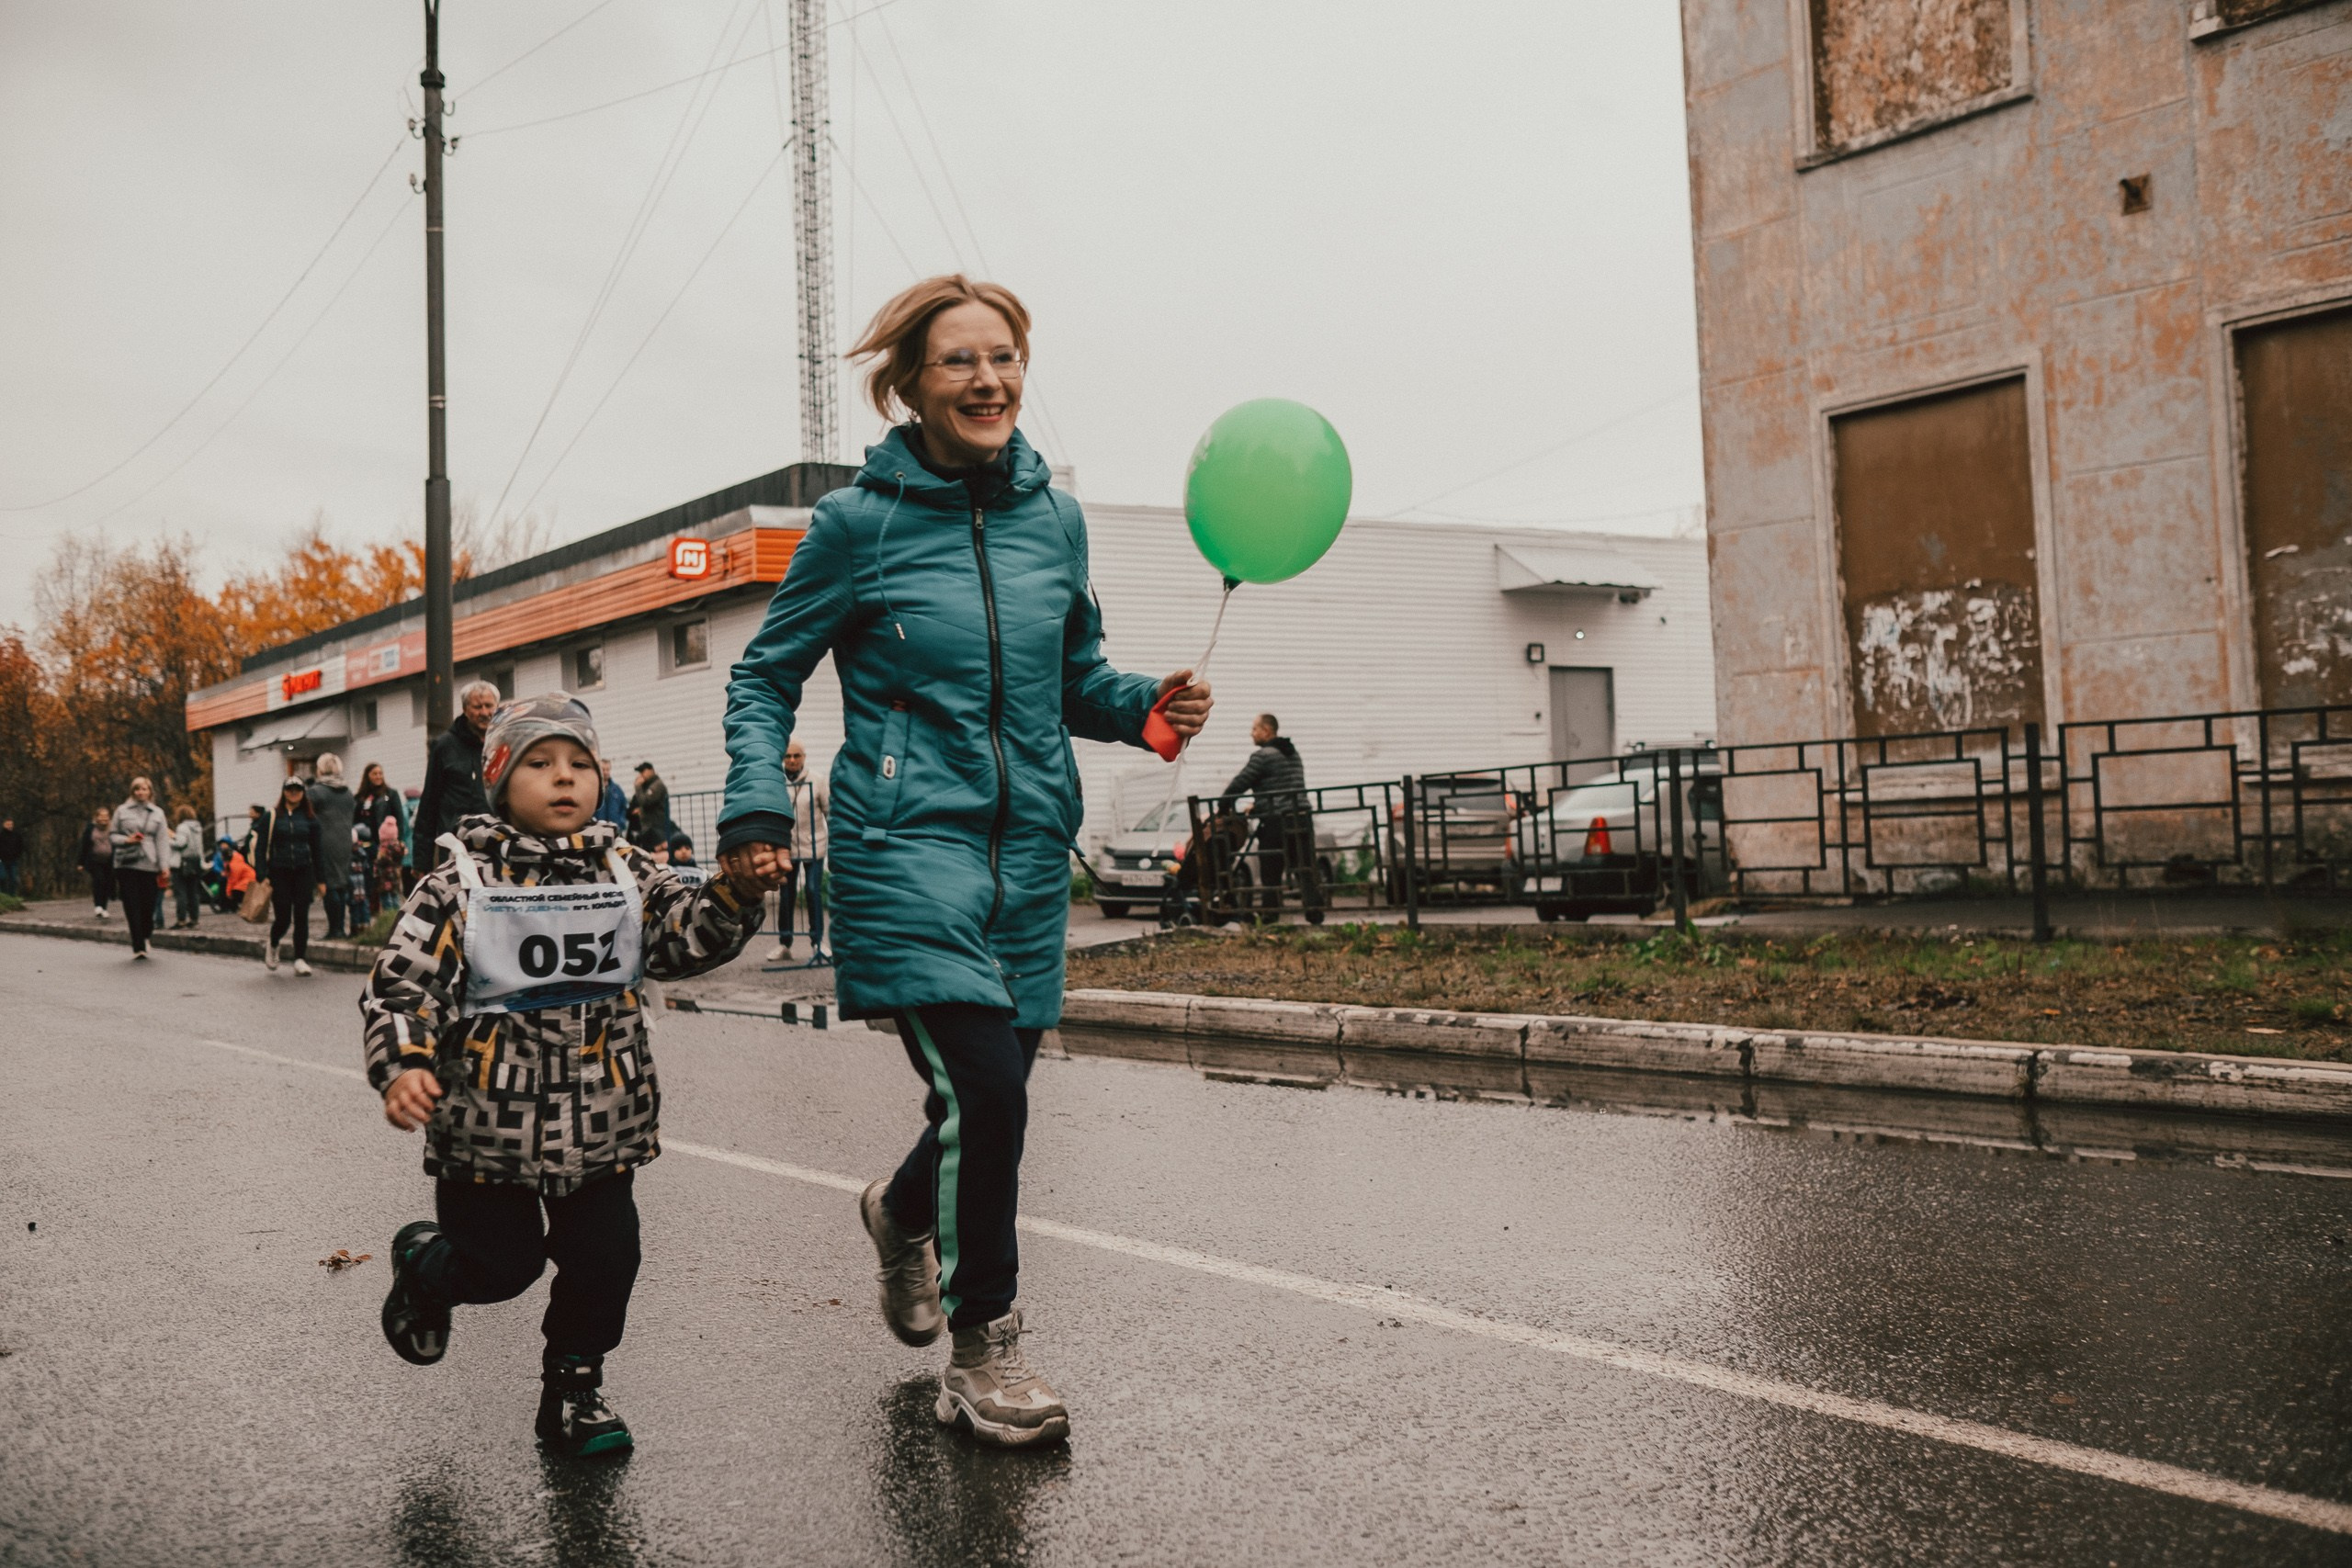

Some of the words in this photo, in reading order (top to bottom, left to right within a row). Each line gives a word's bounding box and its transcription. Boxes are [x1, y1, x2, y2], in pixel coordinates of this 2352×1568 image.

[490, 893, 546, 903] ОБЛАСТНОЙ
[547, 891, 600, 902] СЕМЕЙНЫЙ
[518, 929, 621, 979] 052
